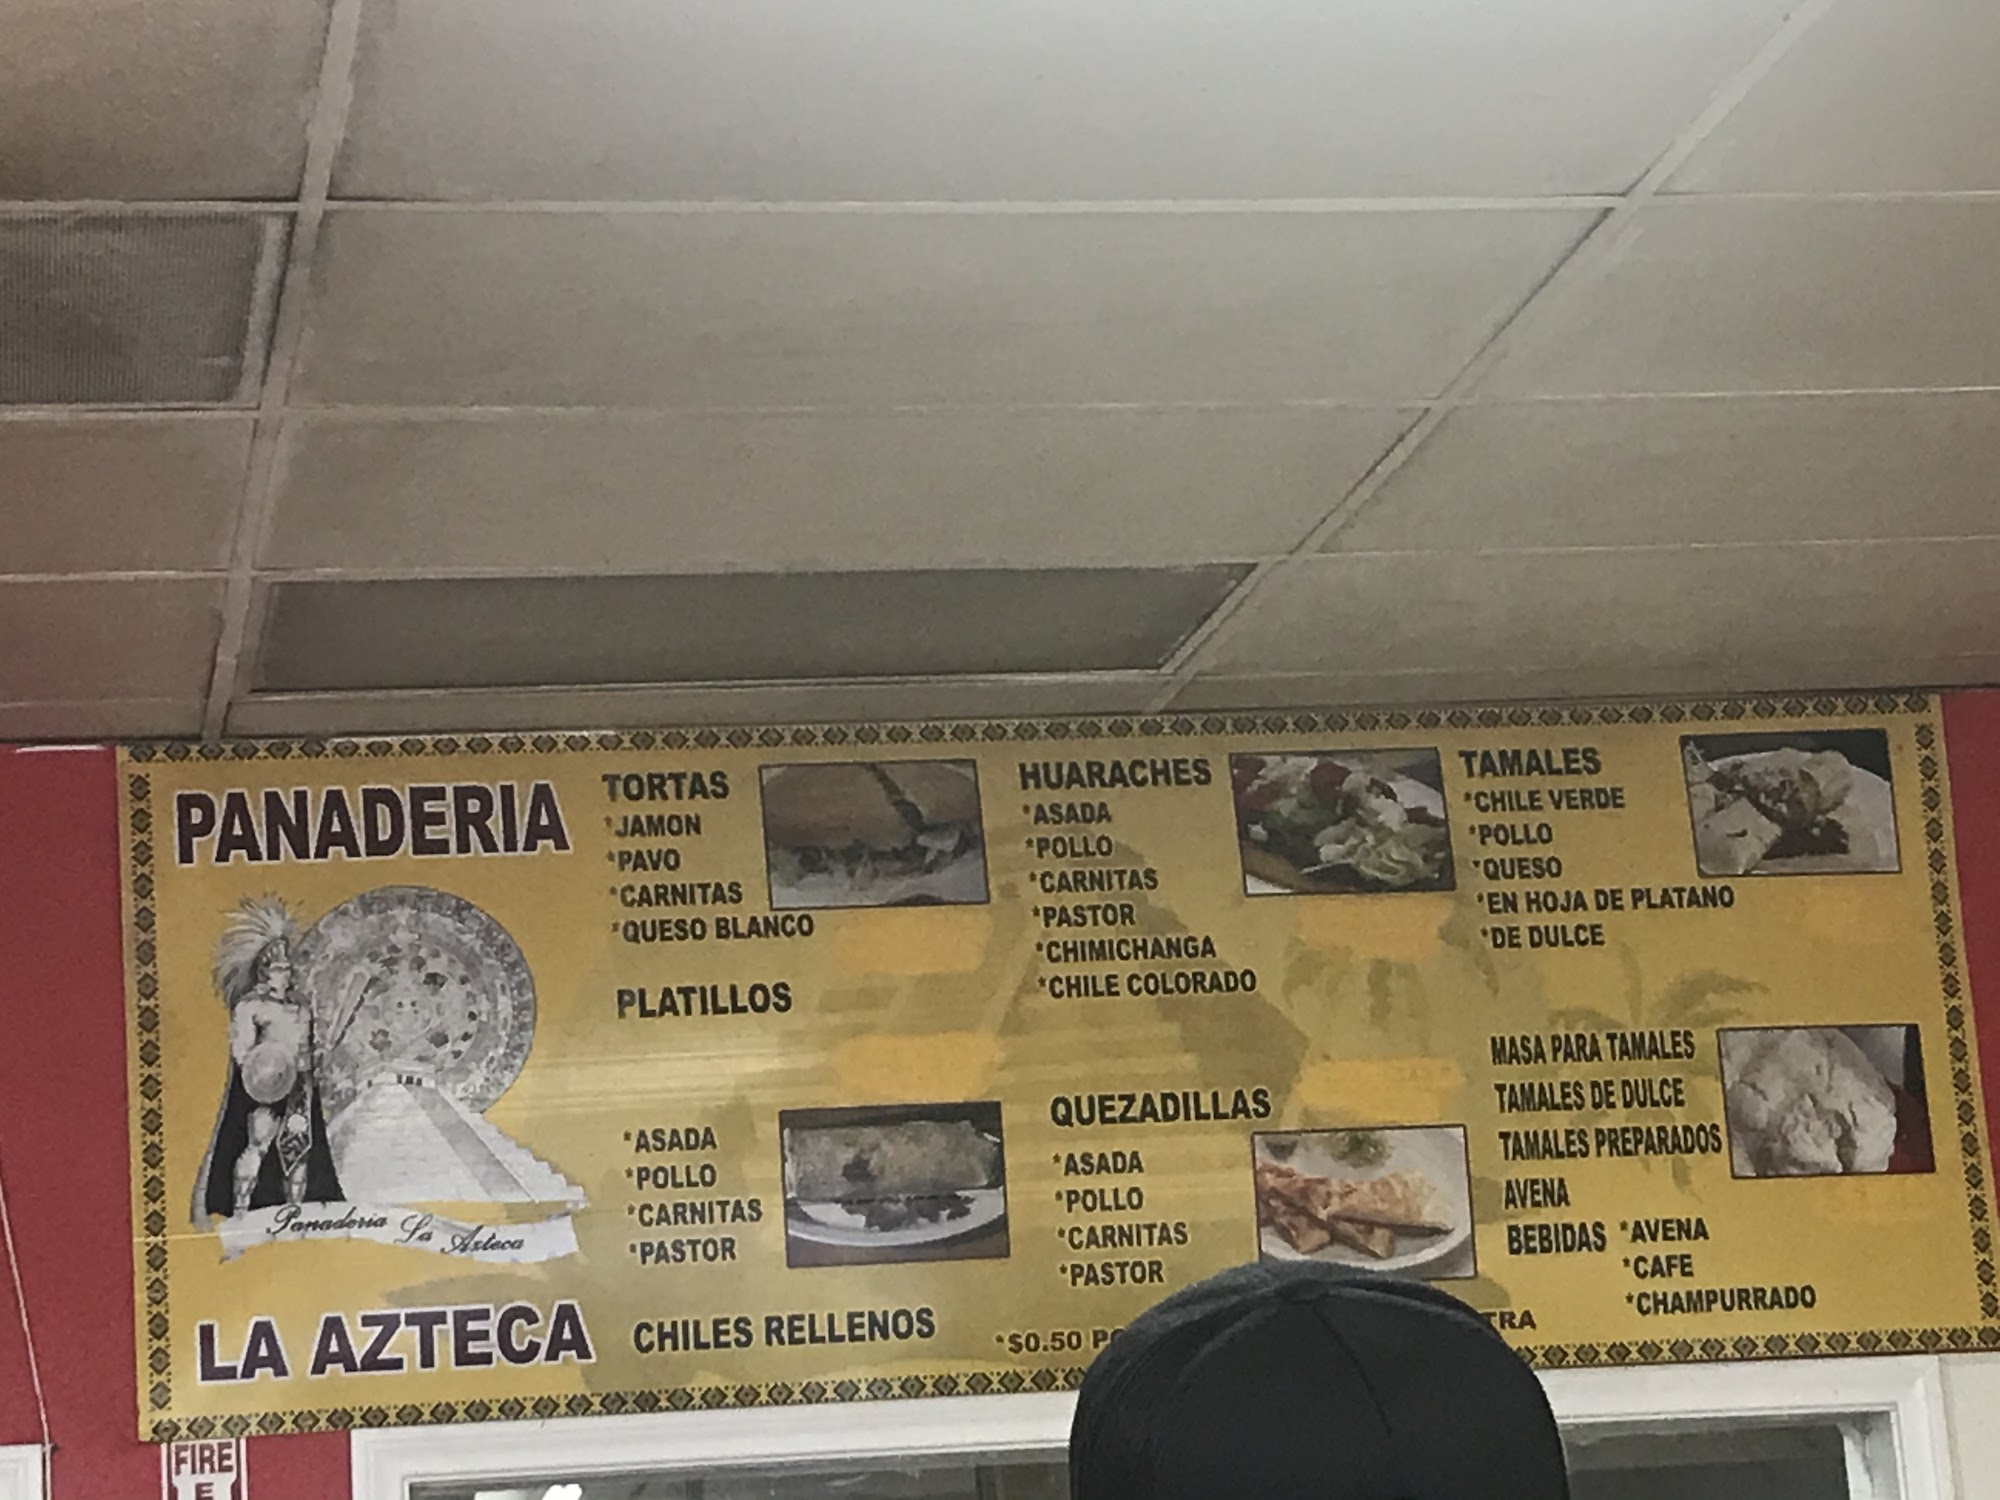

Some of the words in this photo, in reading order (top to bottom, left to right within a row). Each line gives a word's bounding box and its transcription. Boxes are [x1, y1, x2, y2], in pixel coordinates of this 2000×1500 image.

[1019, 758, 1212, 790] HUARACHES
[1458, 747, 1602, 778] TAMALES
[602, 770, 730, 801] TORTAS
[1547, 787, 1626, 811] VERDE
[173, 781, 571, 866] PANADERIA
[1526, 889, 1587, 913] HOJA
[1594, 888, 1624, 911] DE
[1631, 884, 1735, 909] PLATANO
[715, 914, 814, 939] BLANCO
[1529, 923, 1606, 948] DULCE
[1126, 969, 1257, 995] COLORADO
[616, 981, 793, 1019] PLATILLOS
[1490, 1031, 1547, 1066] MASA
[1551, 1033, 1602, 1063] PARA
[1606, 1029, 1696, 1061] TAMALES
[1050, 1088, 1272, 1126] QUEZADILLAS
[1494, 1080, 1584, 1113] TAMALES
[1590, 1079, 1617, 1109] DE
[1622, 1077, 1686, 1108] DULCE
[1498, 1128, 1590, 1161] TAMALES
[1595, 1123, 1723, 1157] PREPARADOS
[1504, 1177, 1570, 1210] AVENA
[1507, 1222, 1607, 1255] BEBIDAS
[198, 1320, 289, 1382] LA
[310, 1303, 595, 1376] AZTECA
[633, 1315, 753, 1354] CHILES
[764, 1307, 935, 1347] RELLENOS
[174, 1441, 234, 1475] FIRE
